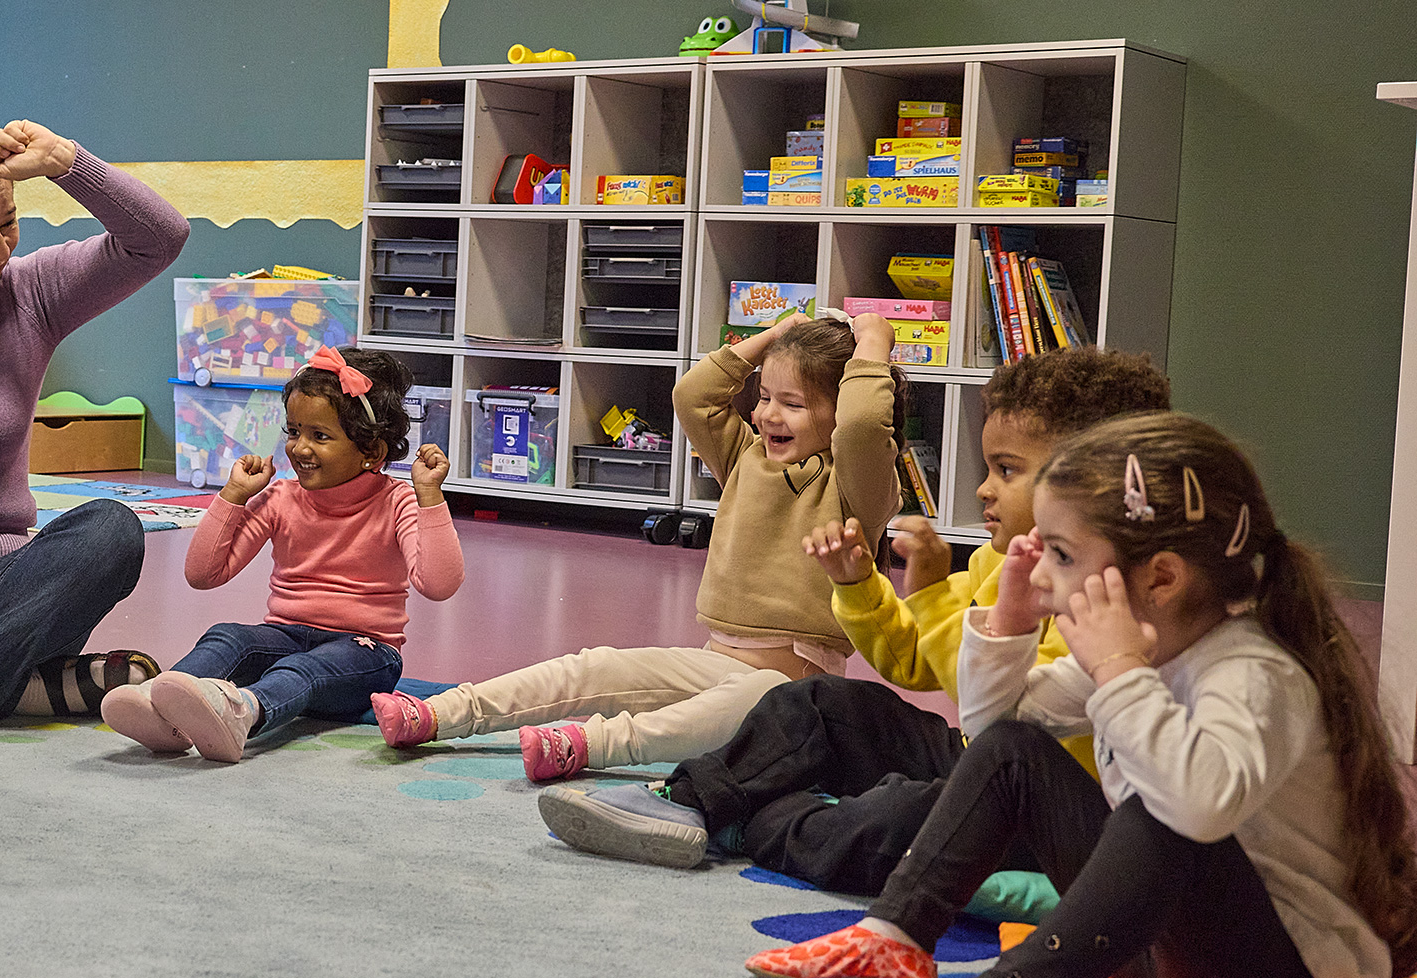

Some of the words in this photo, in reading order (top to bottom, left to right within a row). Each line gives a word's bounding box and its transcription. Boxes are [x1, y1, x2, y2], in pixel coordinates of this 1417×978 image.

[1016, 155, 1044, 164] memo
[906, 184, 939, 201] WURM
[749, 286, 778, 300] Lotti
[741, 296, 788, 316] Karotti
[906, 304, 927, 314] HABA
[924, 325, 945, 335] HABA
[496, 406, 527, 414] GEOSMART
